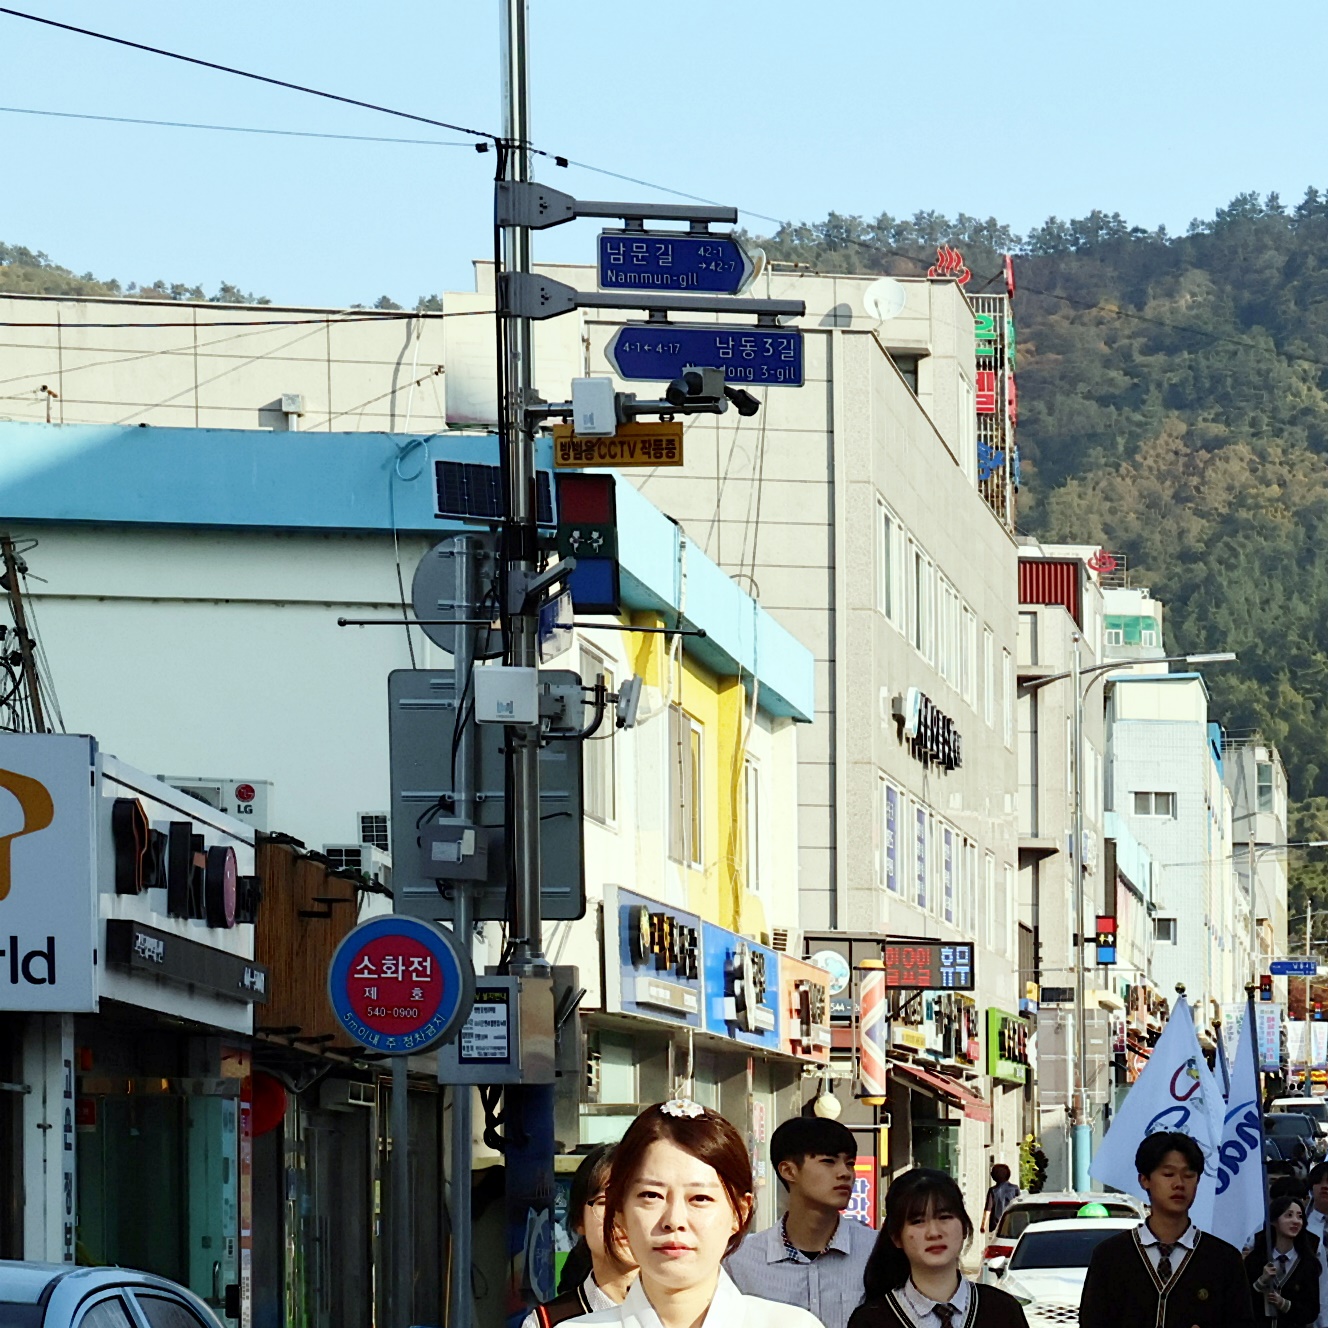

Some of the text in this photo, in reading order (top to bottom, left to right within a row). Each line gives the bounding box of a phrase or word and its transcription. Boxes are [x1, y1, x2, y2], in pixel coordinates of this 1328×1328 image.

[606, 242, 673, 267] 남문길
[697, 246, 722, 258] 42-1
[709, 261, 735, 271] 42-7
[606, 269, 698, 288] Nammun-gil
[623, 342, 680, 354] 4-1 4-17
[716, 336, 795, 361] 남동3길
[760, 366, 795, 382] 3-gil
[597, 440, 638, 460] CCTV
[640, 438, 677, 460] 작동중
[237, 804, 254, 815] LG
[0, 935, 57, 985] ld
[353, 955, 432, 982] 소화전
[363, 987, 425, 1001] 제 호
[367, 1006, 419, 1018] 540-0900
